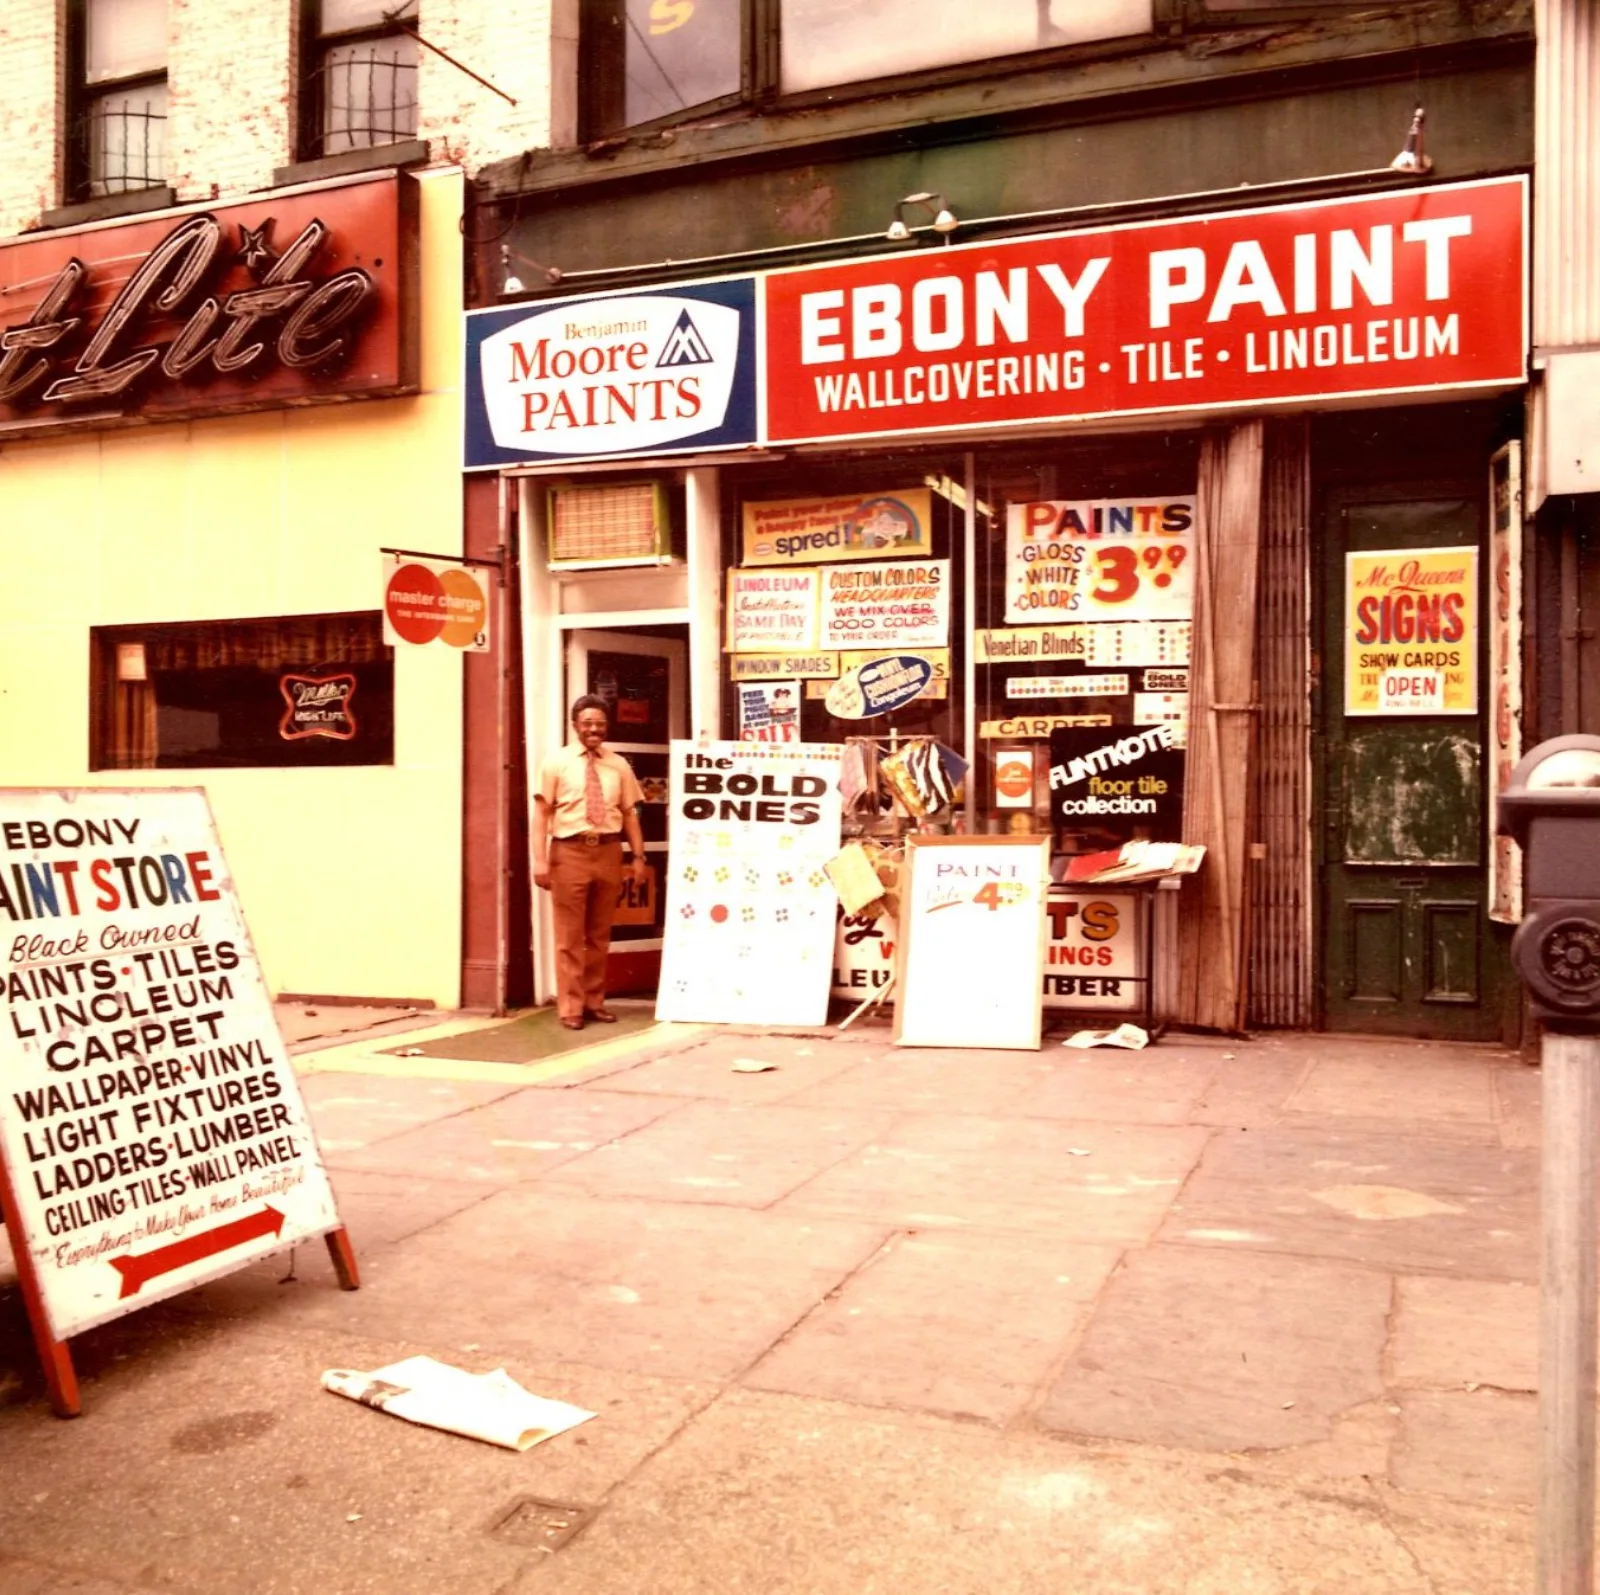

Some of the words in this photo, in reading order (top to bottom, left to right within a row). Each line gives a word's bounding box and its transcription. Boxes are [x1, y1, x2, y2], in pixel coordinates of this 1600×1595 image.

[801, 257, 1112, 365] EBONY
[1150, 215, 1472, 329] PAINT
[43, 212, 374, 401] Lite
[565, 318, 647, 340] Benjamin
[508, 338, 648, 383] Moore
[815, 350, 1085, 413] WALLCOVERING
[1121, 338, 1204, 384] TILE
[1246, 313, 1459, 373] LINOLEUM
[520, 376, 701, 432] PAINTS
[1023, 503, 1192, 539] PAINTS
[1022, 543, 1086, 563] GLOSS
[735, 577, 809, 592] LINOLEUM
[830, 570, 882, 589] CUSTOM
[885, 567, 941, 586] COLORS
[1025, 566, 1080, 586] WHITE
[834, 606, 854, 617] WE
[859, 605, 885, 616] MIX
[889, 603, 935, 615] OVER
[1018, 589, 1082, 611] COLORS
[780, 613, 807, 628] DAY
[883, 615, 939, 628] COLORS
[1356, 592, 1465, 645] SIGNS
[984, 633, 1038, 656] Venetian
[1041, 631, 1085, 654] Blinds
[785, 658, 832, 673] SHADES
[1359, 653, 1400, 668] SHOW
[1404, 651, 1461, 667] CARDS
[1385, 677, 1437, 696] OPEN
[684, 754, 734, 770] the
[684, 773, 827, 797] BOLD
[1089, 776, 1134, 795] floor
[1137, 775, 1169, 795] tile
[683, 798, 820, 825] ONES
[1062, 796, 1157, 815] collection
[2, 819, 140, 850] EBONY
[90, 851, 220, 912] STORE
[937, 864, 1018, 877] PAINT
[1047, 901, 1120, 942] TS
[9, 930, 89, 962] Black
[100, 915, 200, 950] Owned
[133, 941, 240, 982] TILES
[10, 976, 234, 1038] LINOLEUM
[46, 1011, 225, 1072] CARPET
[13, 1058, 187, 1122] WALLPAPER
[189, 1039, 273, 1080] VINYL
[23, 1109, 119, 1163] LIGHT
[132, 1071, 282, 1133] FIXTURES
[33, 1137, 169, 1200] LADDERS
[172, 1103, 293, 1159] LUMBER
[45, 1189, 126, 1236] CEILING
[126, 1169, 187, 1209] TILES
